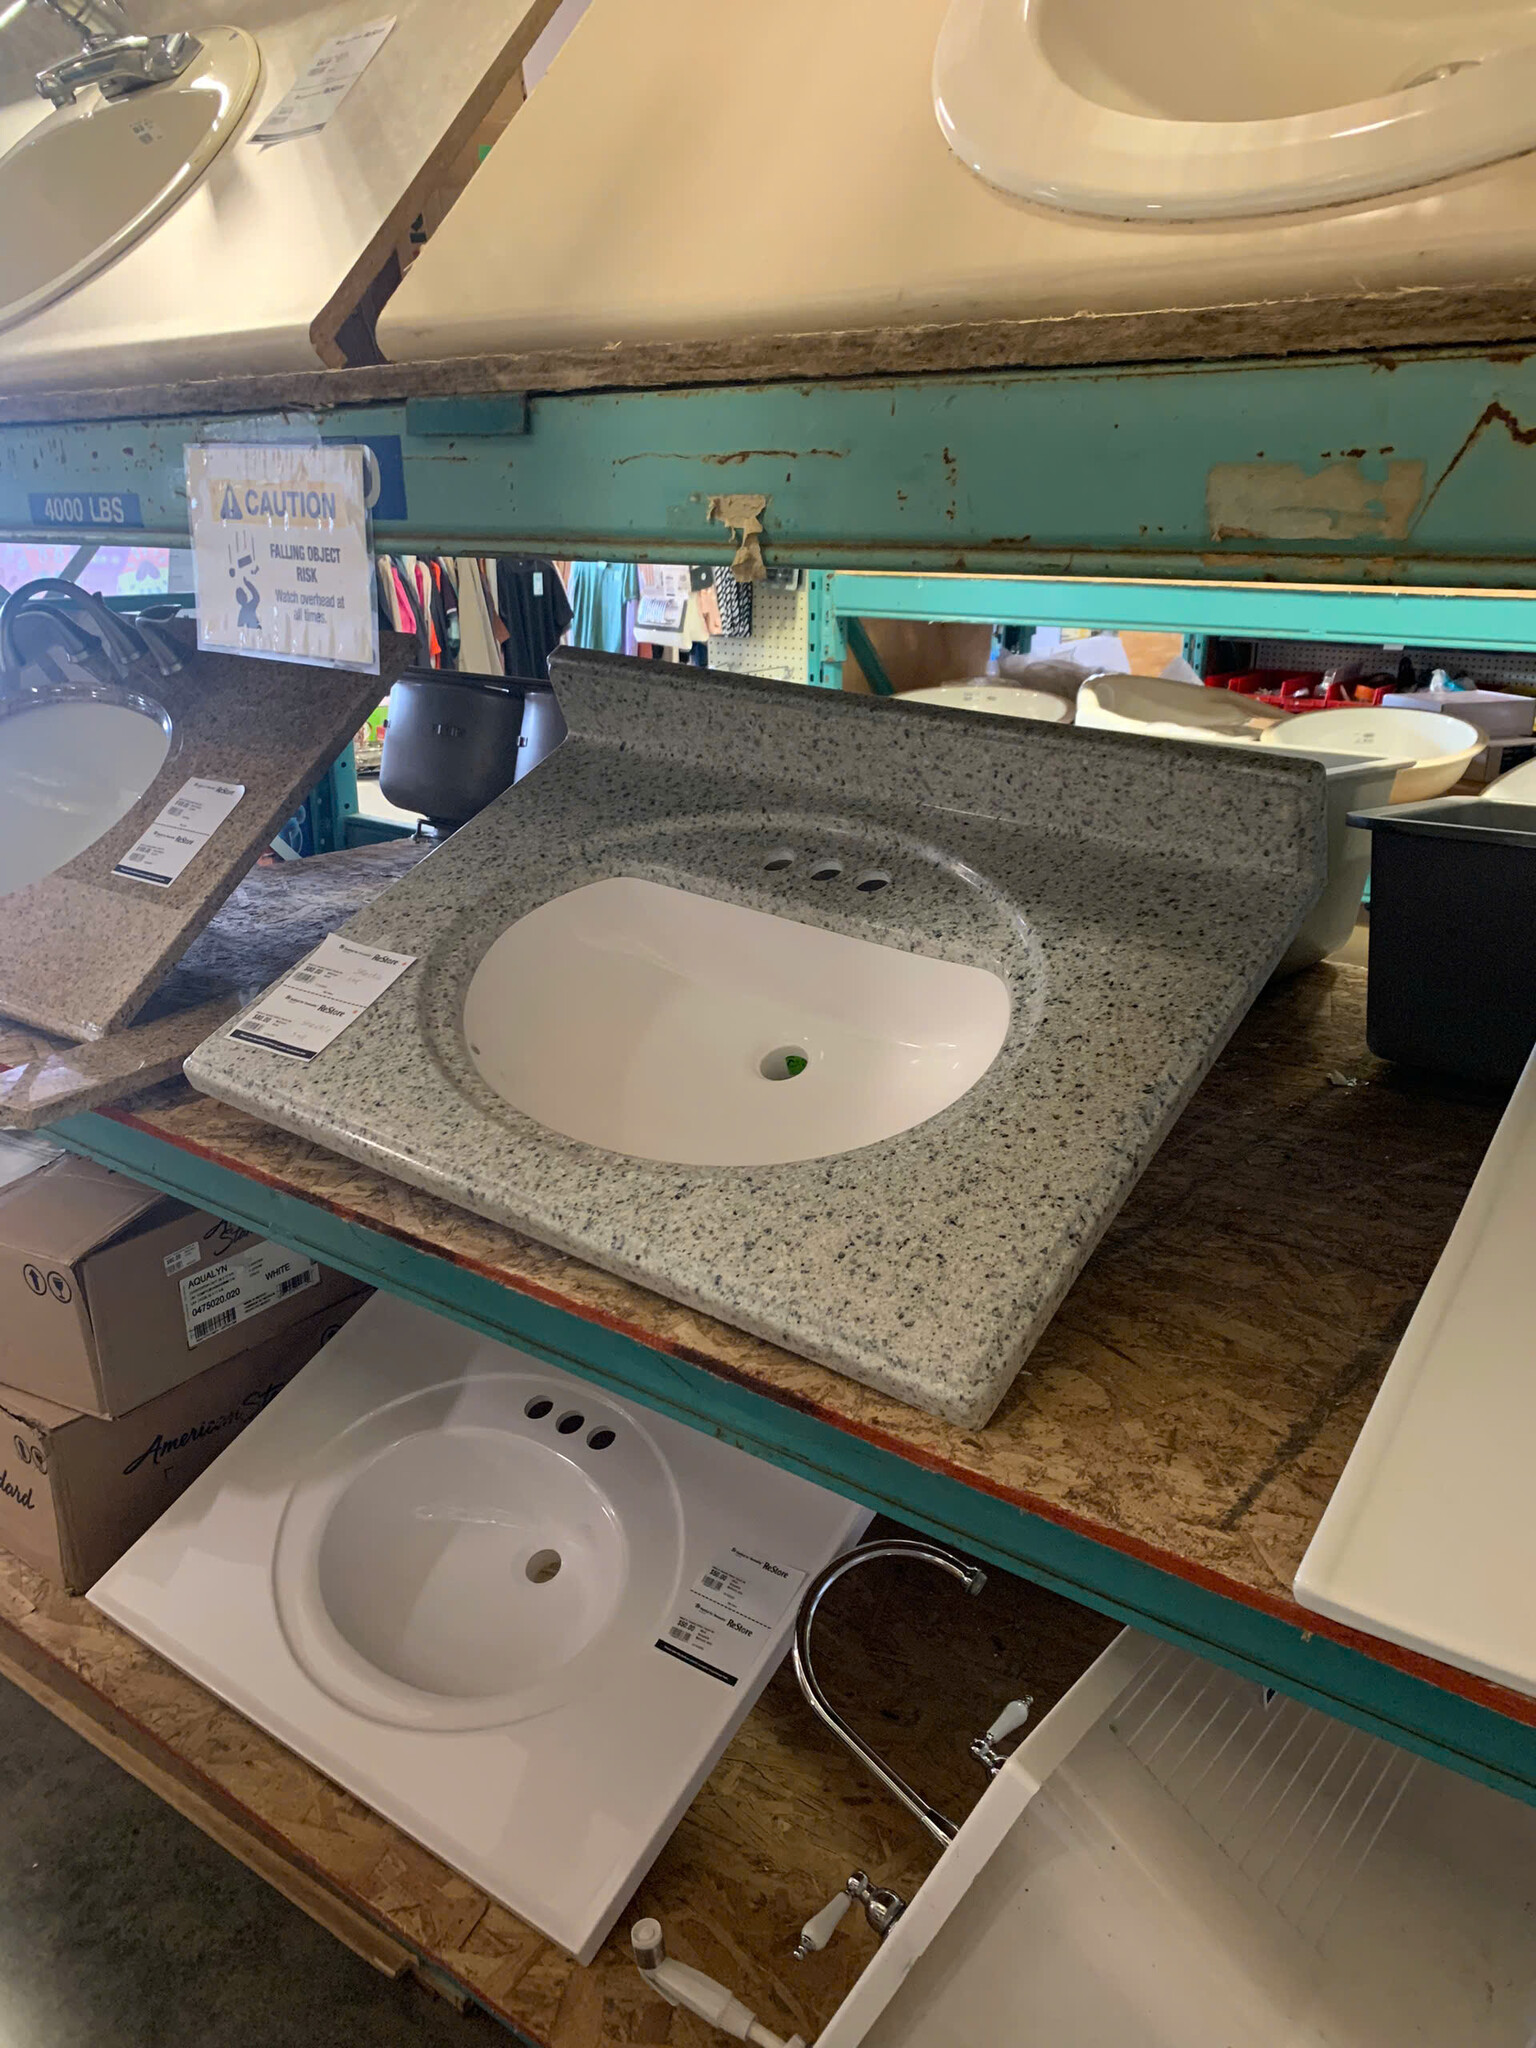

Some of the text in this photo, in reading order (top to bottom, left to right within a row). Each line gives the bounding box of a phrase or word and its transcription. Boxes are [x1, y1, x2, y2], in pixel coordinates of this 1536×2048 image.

[44, 496, 125, 523] 4000 LBS
[245, 489, 336, 519] CAUTION
[269, 543, 341, 563] FALLING OBJECT
[296, 566, 318, 583] RISK
[275, 589, 345, 609] Watch overhead at
[317, 1004, 345, 1017] ReStore
[188, 1264, 228, 1289] AQUALYN
[265, 1263, 291, 1281] WHITE
[192, 1287, 241, 1317] 0475020.020
[122, 1409, 242, 1475] American
[762, 1561, 789, 1579] ReStore
[726, 1618, 753, 1638] ReStore
